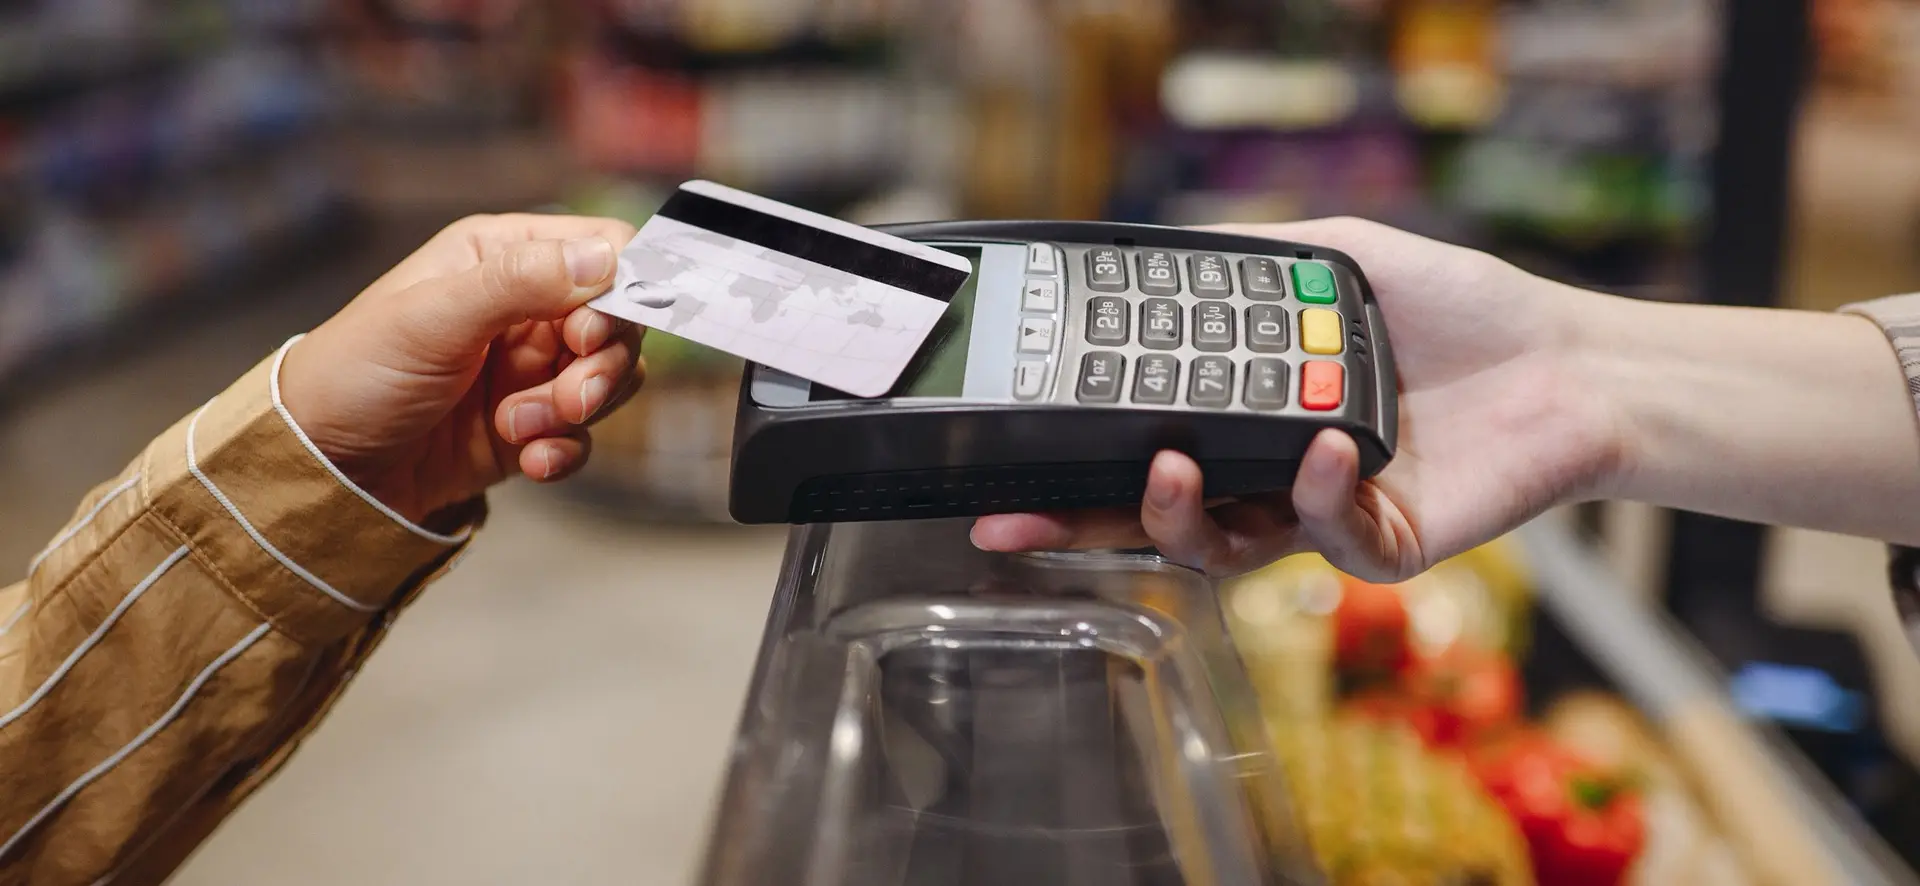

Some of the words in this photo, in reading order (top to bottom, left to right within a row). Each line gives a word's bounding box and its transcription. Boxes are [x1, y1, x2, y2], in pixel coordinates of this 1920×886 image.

[1095, 263, 1117, 275] 3
[1148, 268, 1170, 279] 6
[1200, 270, 1222, 282] 9
[1096, 316, 1119, 329] 2
[1150, 317, 1173, 330] 5
[1203, 321, 1226, 334] 8
[1257, 322, 1280, 335] 0
[1087, 376, 1111, 386] 1
[1143, 376, 1167, 392] 4
[1199, 378, 1223, 392] 7
